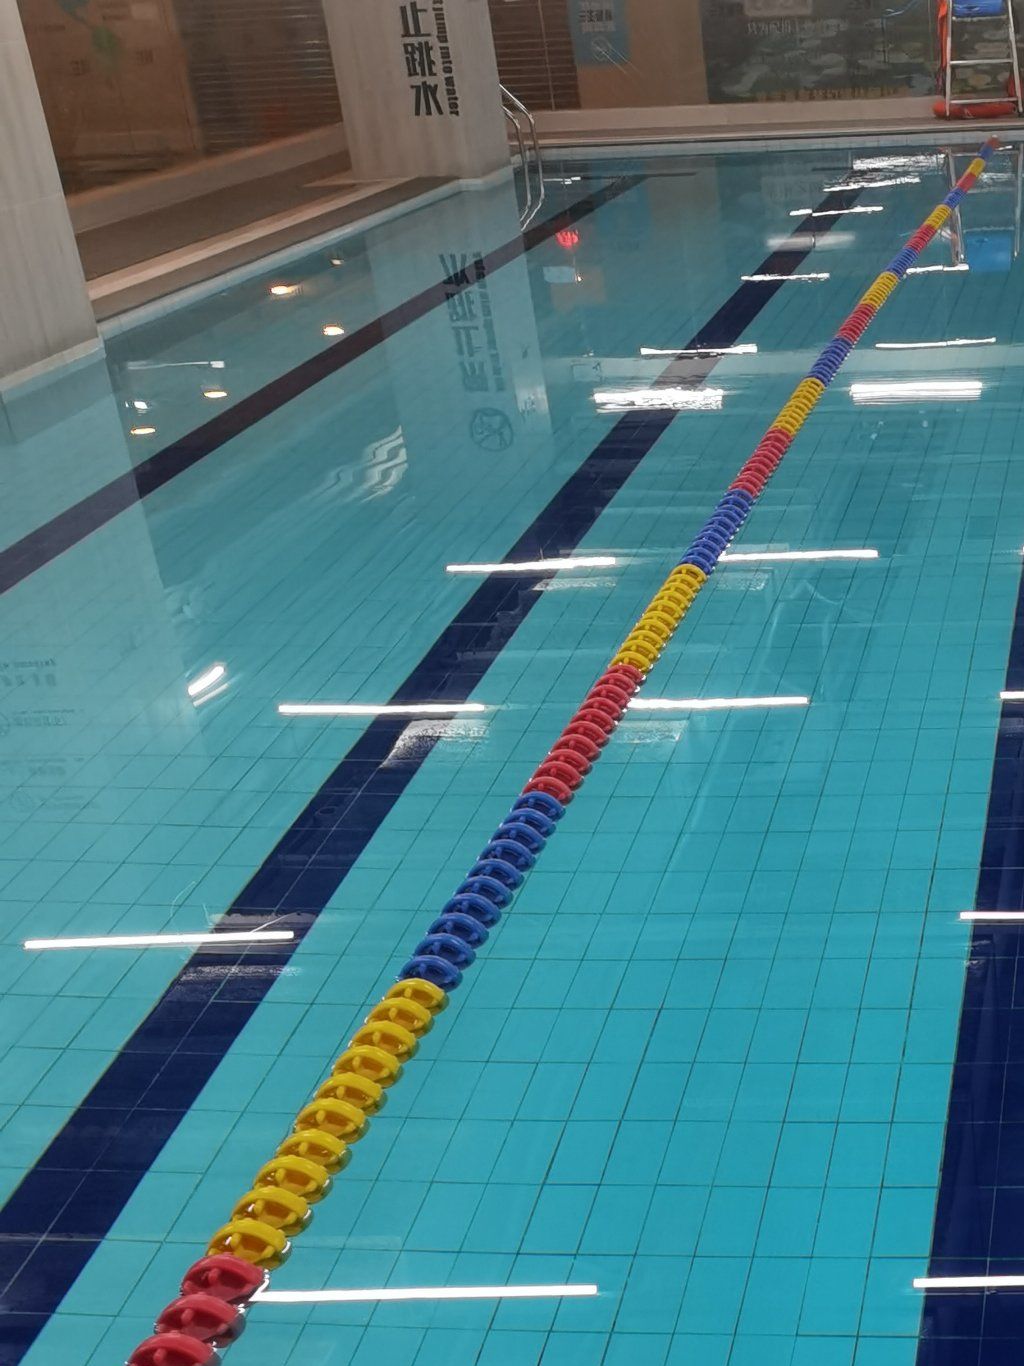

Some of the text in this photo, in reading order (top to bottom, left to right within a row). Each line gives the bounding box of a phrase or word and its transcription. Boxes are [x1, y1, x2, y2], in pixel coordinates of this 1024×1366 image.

[400, 1, 444, 117] 止跳水
[444, 76, 460, 117] water
